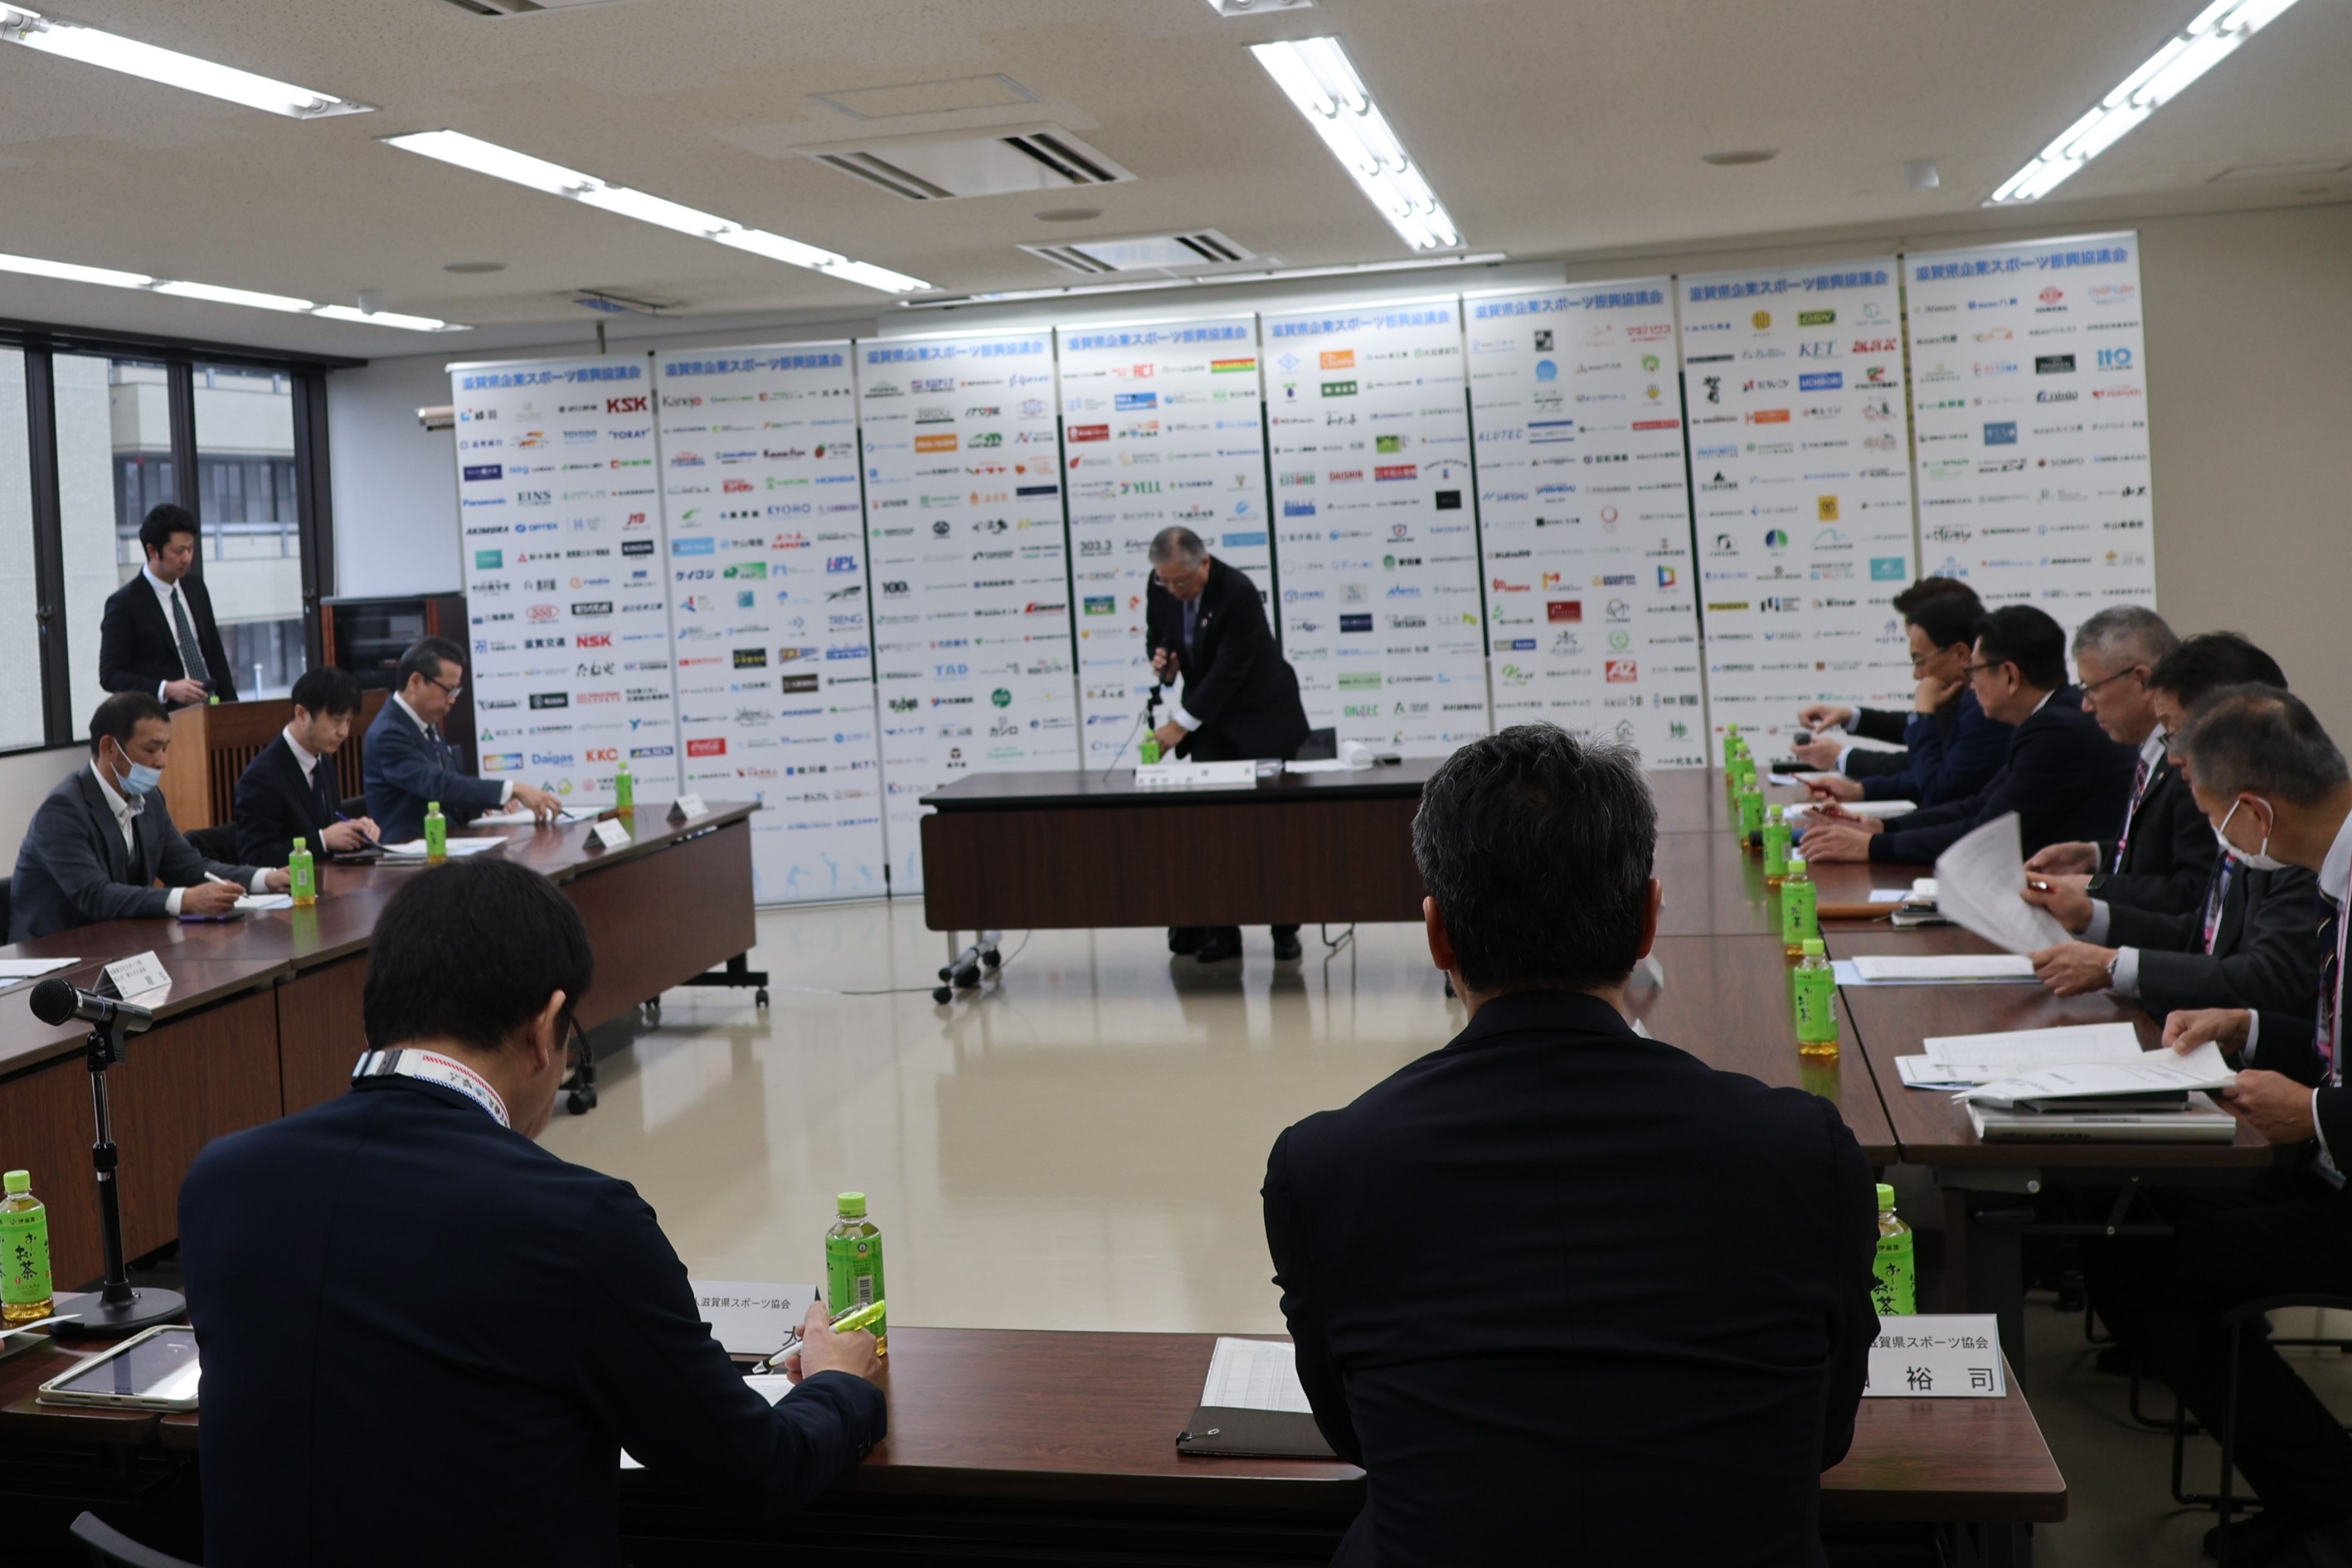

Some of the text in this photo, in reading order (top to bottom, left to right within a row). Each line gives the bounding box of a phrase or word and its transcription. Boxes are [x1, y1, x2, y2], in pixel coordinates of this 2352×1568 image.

[1916, 247, 2129, 282] 滋賀県企業スポーツ振興協議会
[1690, 270, 1888, 303] 滋賀県企業スポーツ振興協議会
[1476, 291, 1664, 319] 滋賀県企業スポーツ振興協議会
[1271, 310, 1451, 338] 滋賀県企業スポーツ振興協議会
[1068, 326, 1247, 350] 滋賀県企業スポーツ振興協議会
[867, 341, 1044, 364] 滋賀県企業スポーツ振興協議会
[665, 353, 843, 376] 滋賀県企業スポーツ振興協議会
[462, 365, 641, 391] 滋賀県企業スポーツ振興協議会
[606, 396, 648, 414] KSK
[1478, 429, 1523, 442] ALUTEC
[1133, 481, 1162, 494] YELL
[463, 498, 507, 507] Panasonic
[767, 503, 811, 515] KYOHO
[524, 638, 566, 649] 滋賀交通
[576, 635, 613, 648] NSK
[532, 754, 574, 766] Daigas
[586, 748, 619, 763] KKC
[1967, 1367, 1995, 1392] 司
